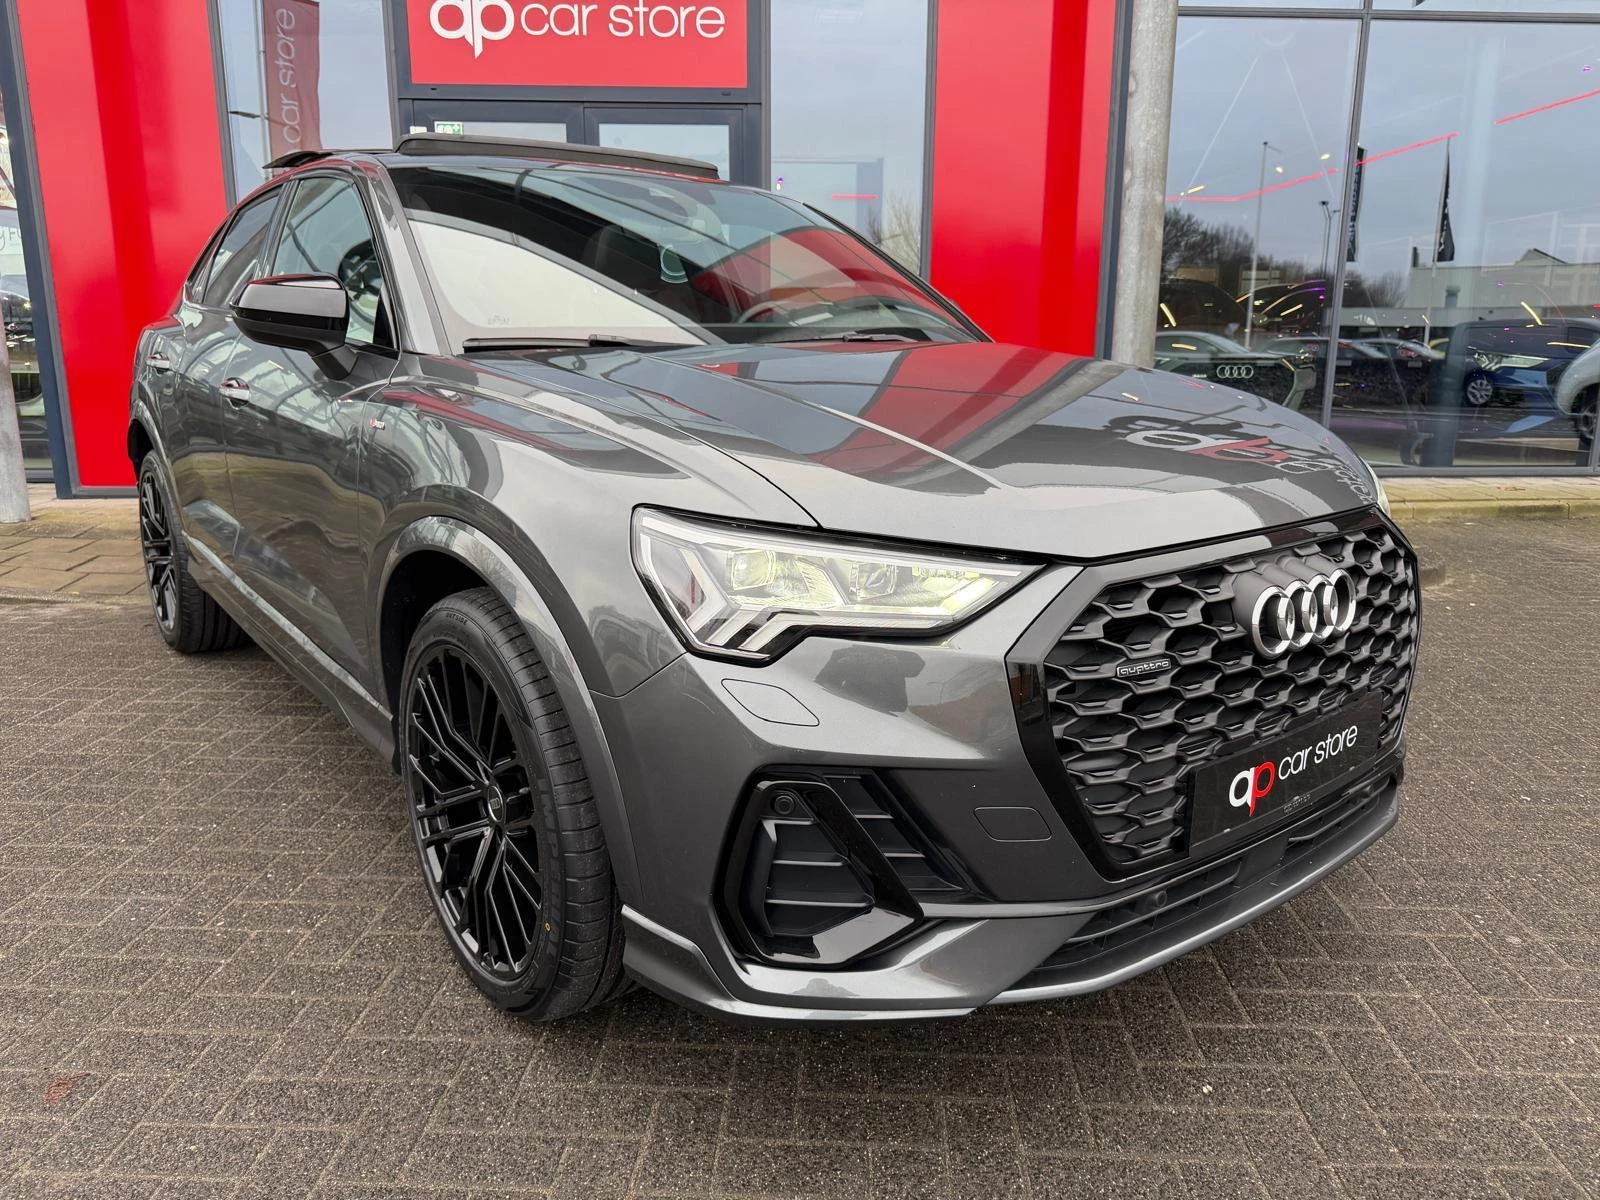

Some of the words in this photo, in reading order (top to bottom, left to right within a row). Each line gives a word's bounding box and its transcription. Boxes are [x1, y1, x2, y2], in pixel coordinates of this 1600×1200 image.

[520, 3, 598, 36] car
[608, 0, 726, 38] store
[273, 8, 297, 88] store
[280, 93, 302, 144] car
[1120, 661, 1169, 675] quattro
[1229, 762, 1276, 817] ap
[1278, 746, 1313, 780] car
[1314, 725, 1358, 763] store
